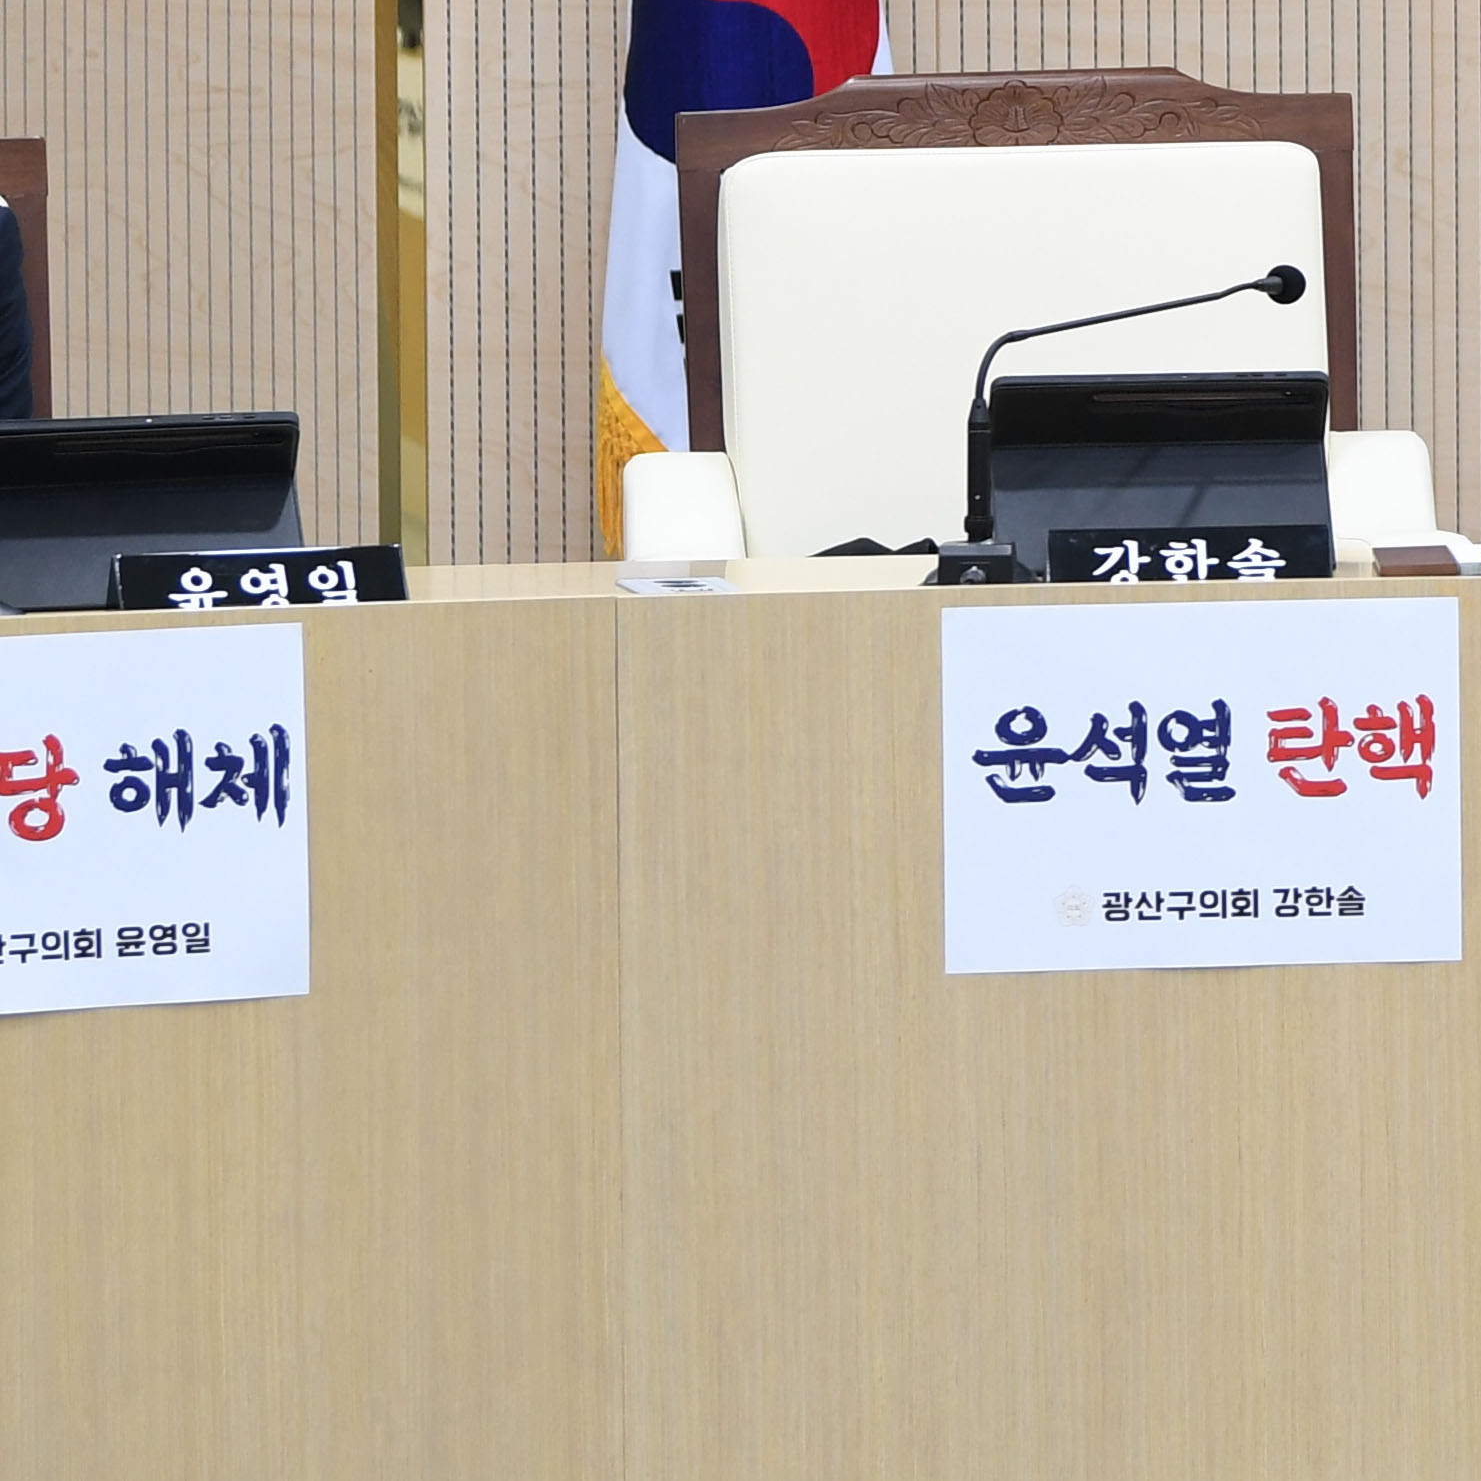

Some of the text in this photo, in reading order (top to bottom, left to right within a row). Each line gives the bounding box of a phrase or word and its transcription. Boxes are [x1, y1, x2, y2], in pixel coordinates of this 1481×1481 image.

[103, 723, 290, 833] 해체
[972, 693, 1436, 805] 윤석열 탄핵
[1102, 886, 1366, 922] 광산구의회 강한솔
[0, 922, 211, 964] 구의회 윤영일
